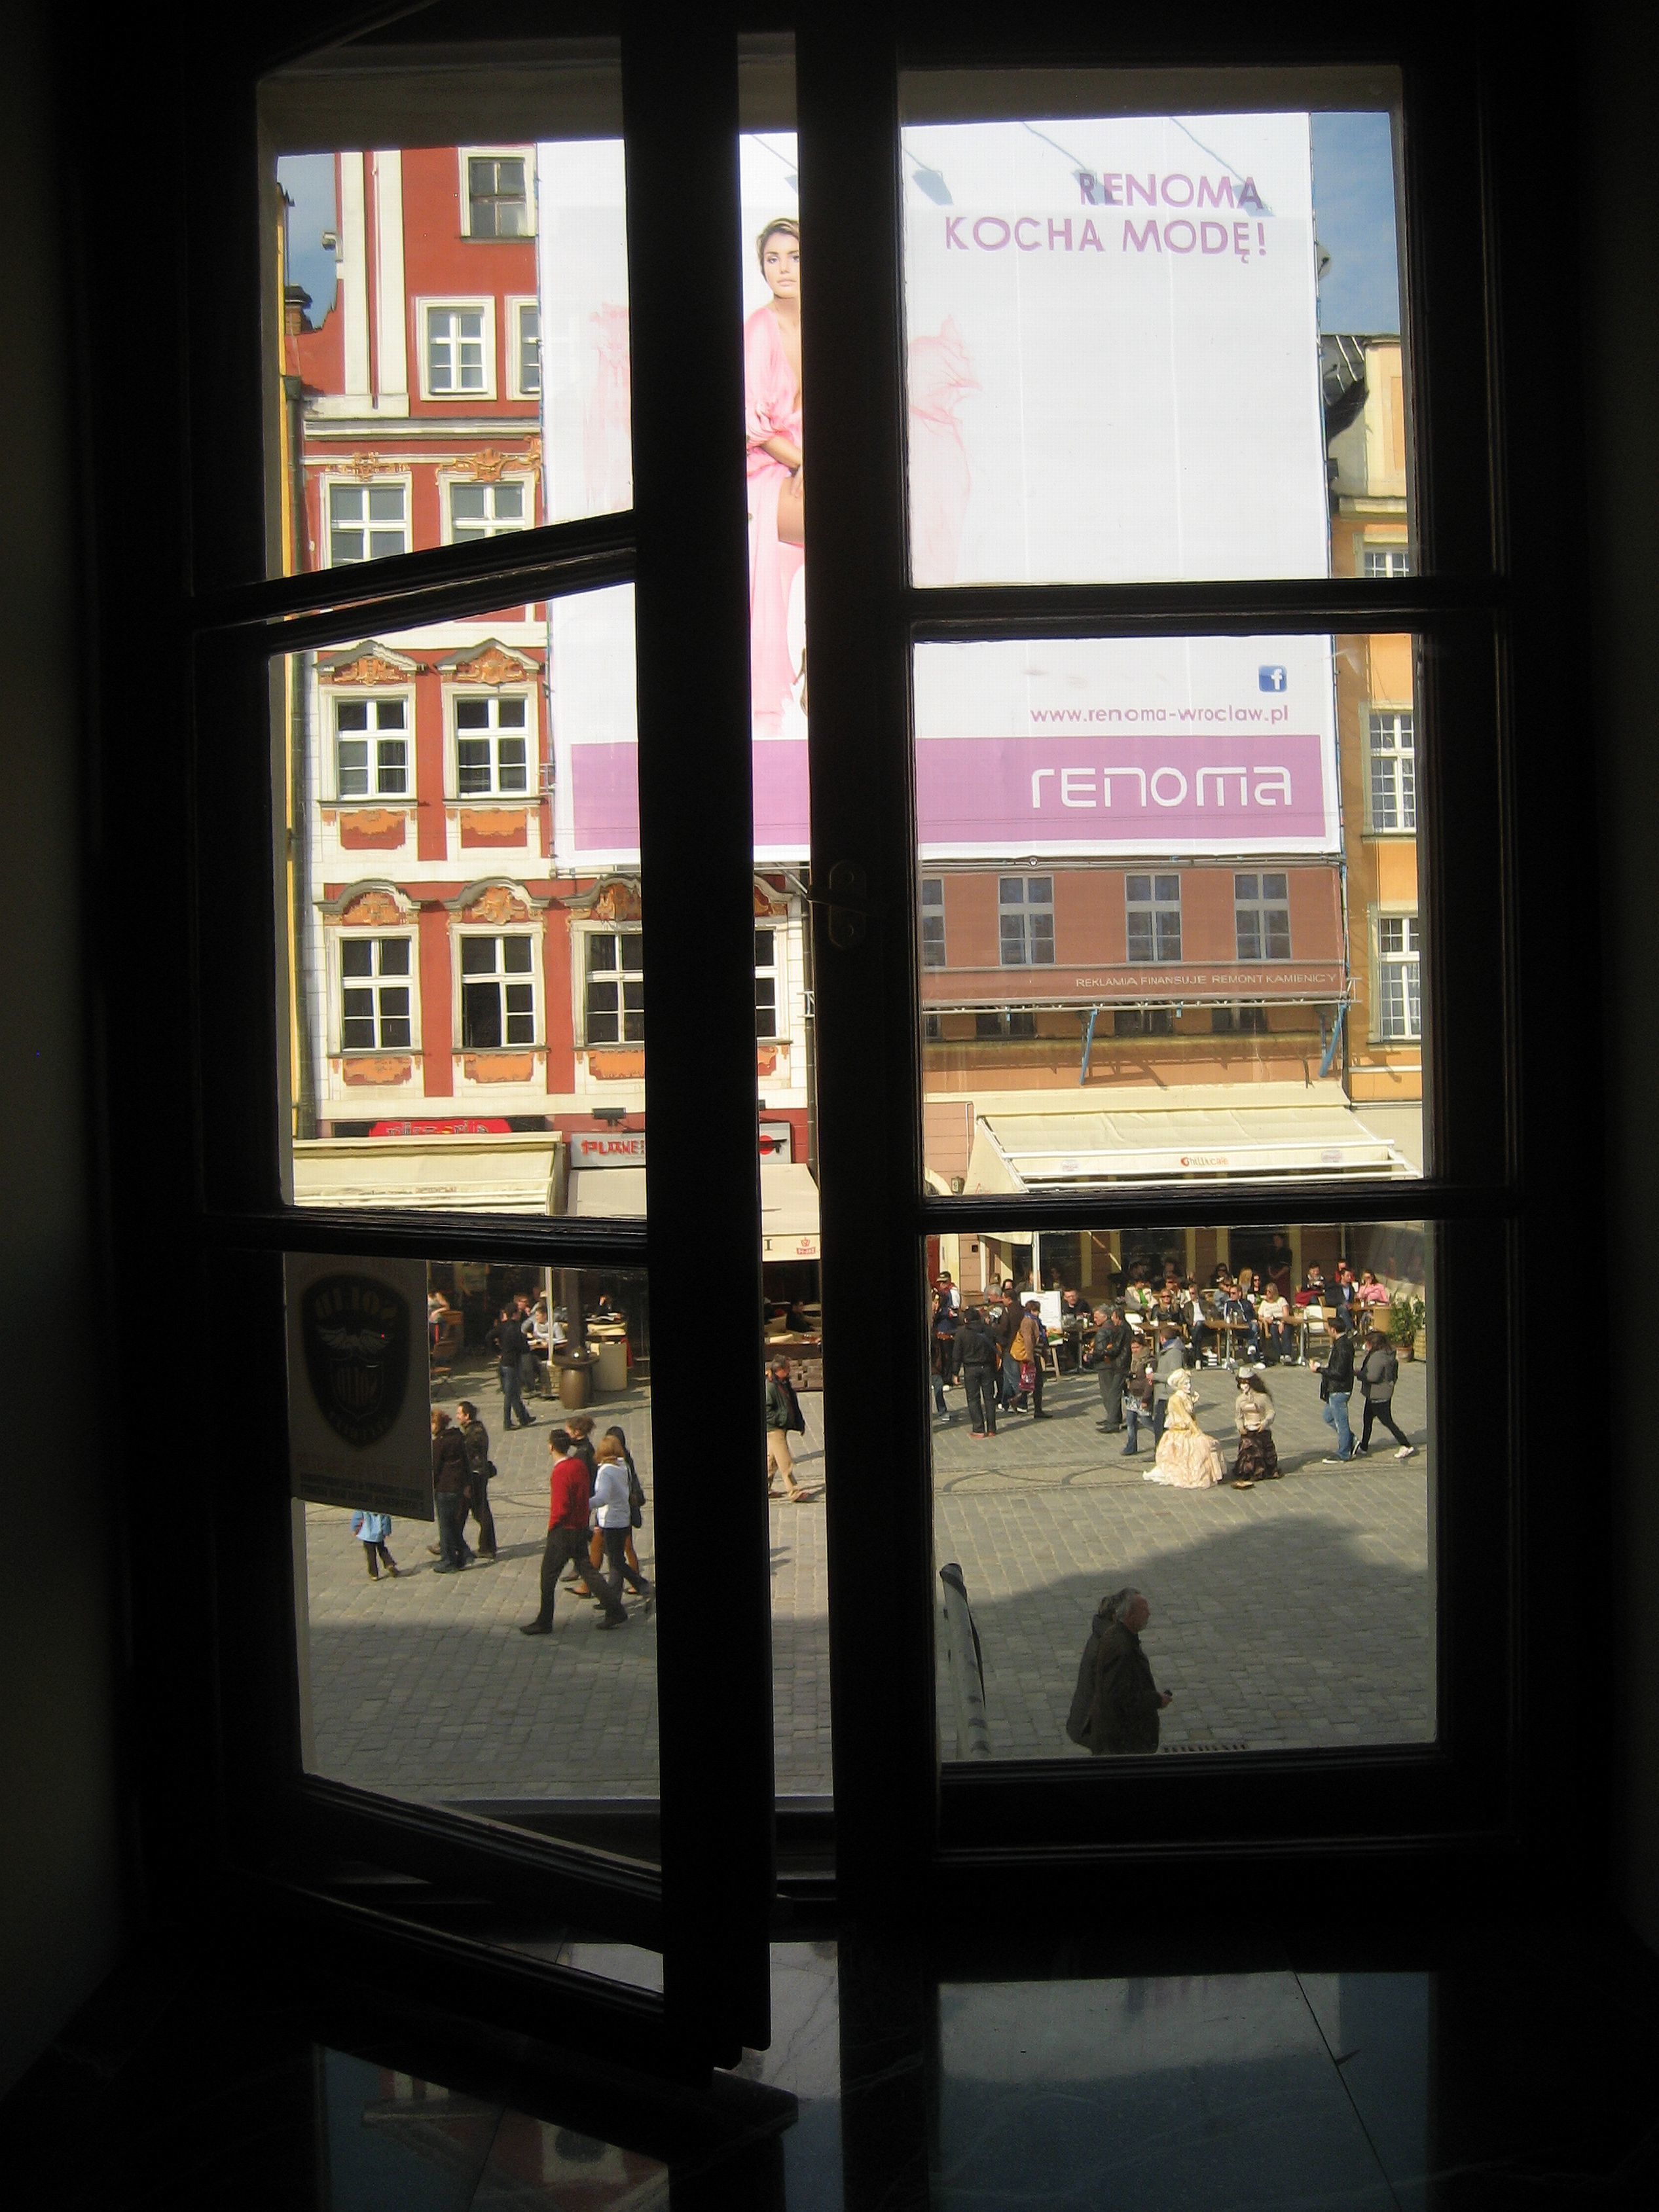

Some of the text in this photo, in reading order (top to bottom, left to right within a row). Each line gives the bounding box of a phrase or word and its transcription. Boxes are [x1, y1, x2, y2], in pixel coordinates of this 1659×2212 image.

[1079, 172, 1264, 210] RENOMA
[945, 215, 1267, 264] KOCHA MODĘ!
[1030, 704, 1289, 725] www.renoma-wroclaw.pl
[1031, 766, 1292, 809] renoma
[1075, 973, 1337, 988] REKLAMA FINANSUJE REMONT KAMIENICY
